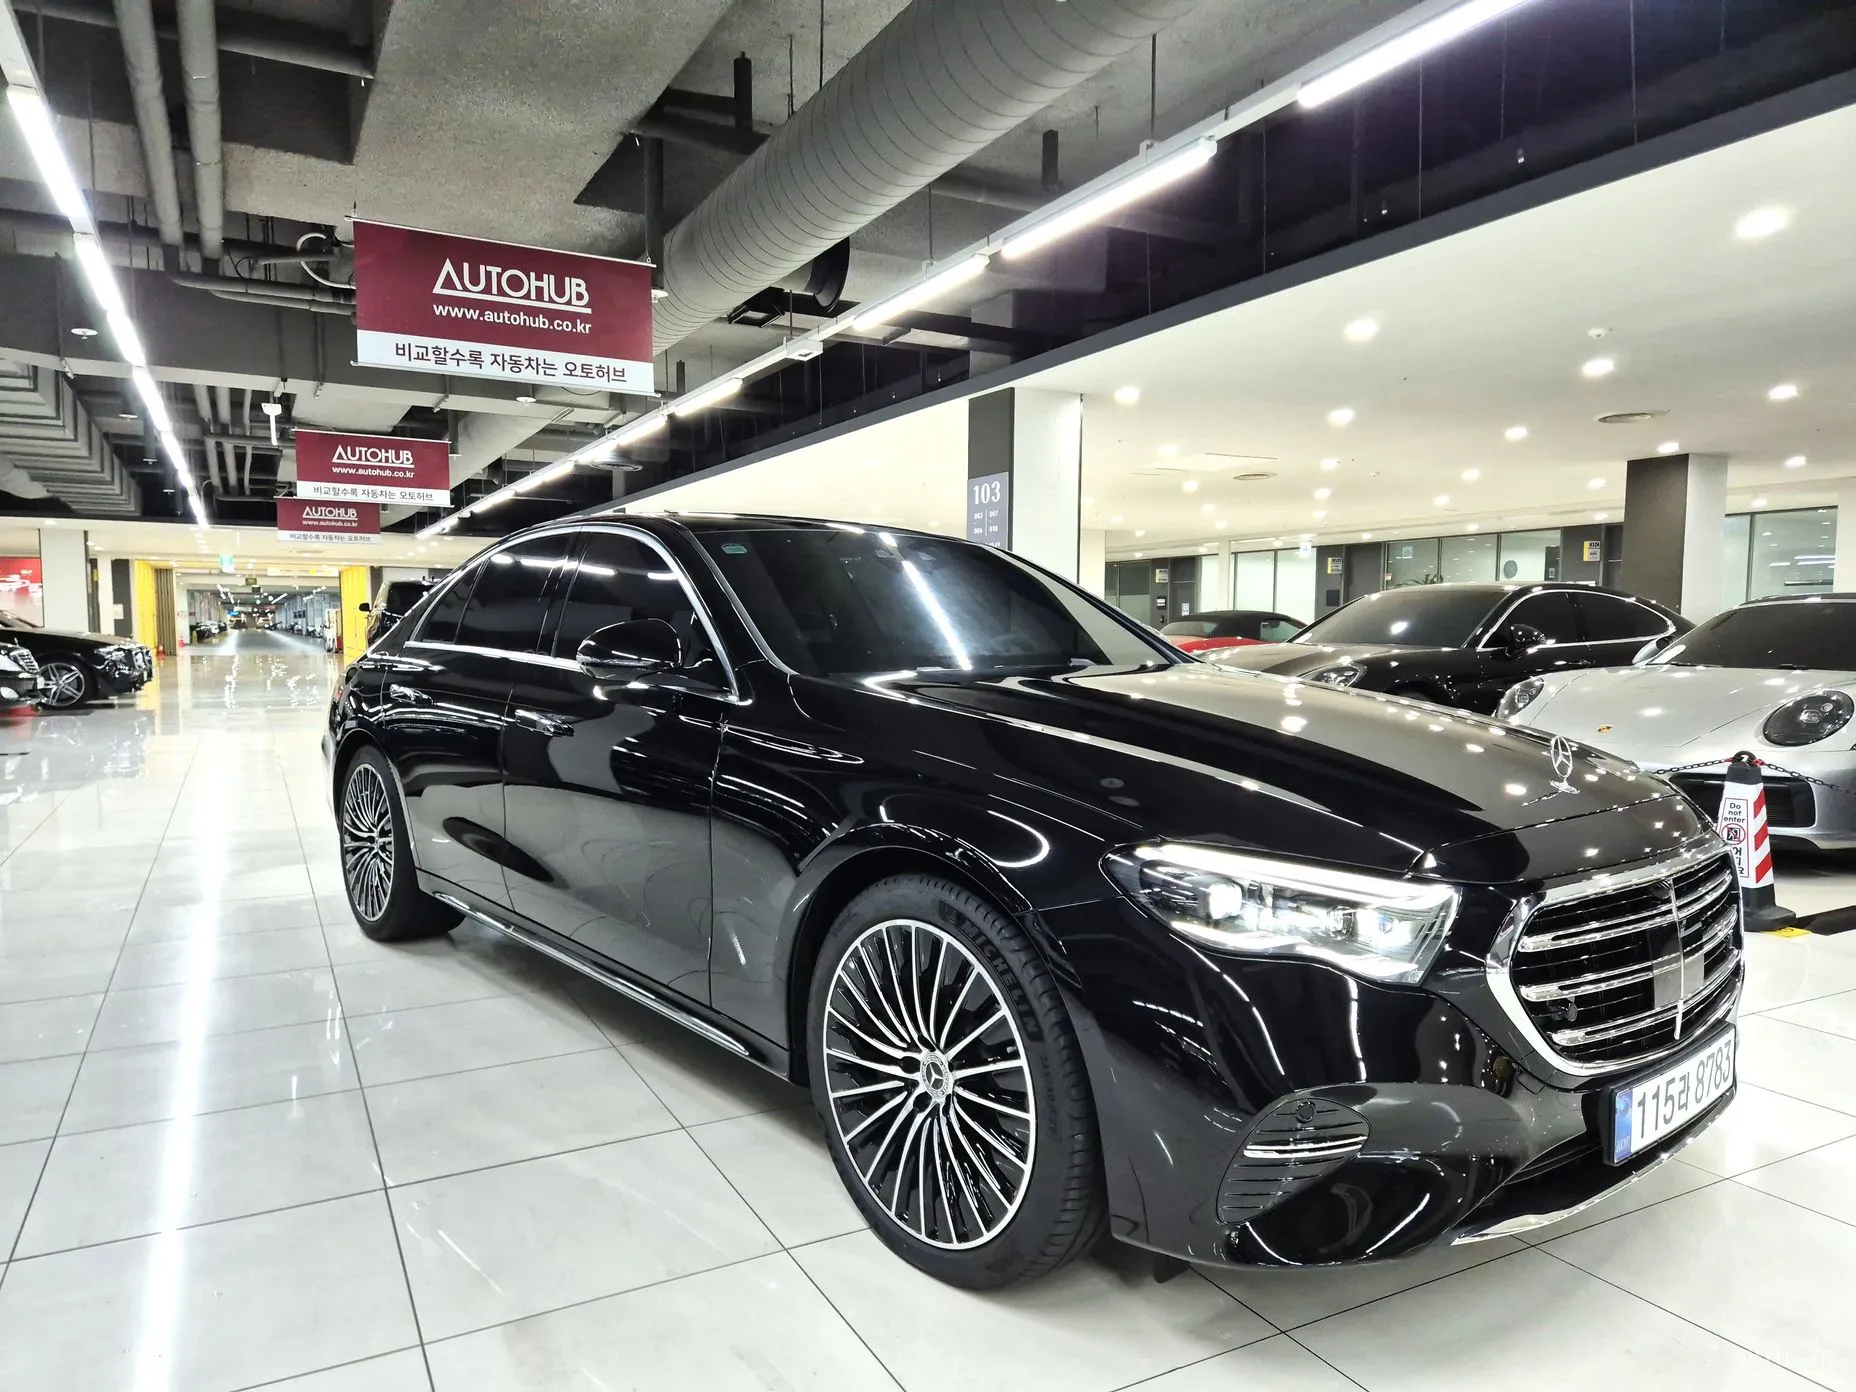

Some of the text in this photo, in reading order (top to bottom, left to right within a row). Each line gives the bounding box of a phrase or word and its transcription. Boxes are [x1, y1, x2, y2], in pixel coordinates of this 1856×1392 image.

[432, 258, 591, 311] AUTOHUB
[433, 304, 592, 334] www.autohub.co.kr
[395, 342, 628, 384] 비교할수록 자동차는 오토허브
[332, 445, 414, 466] AUTOHUB
[332, 465, 415, 478] www.autohub.co.kr
[314, 486, 434, 502] 비교할수록 자동차는 오토허브
[973, 481, 1000, 504] 103
[302, 506, 358, 520] AUTOHUB
[1729, 802, 1741, 810] Do
[1723, 816, 1746, 824] enter
[1695, 1039, 1732, 1105] 8783
